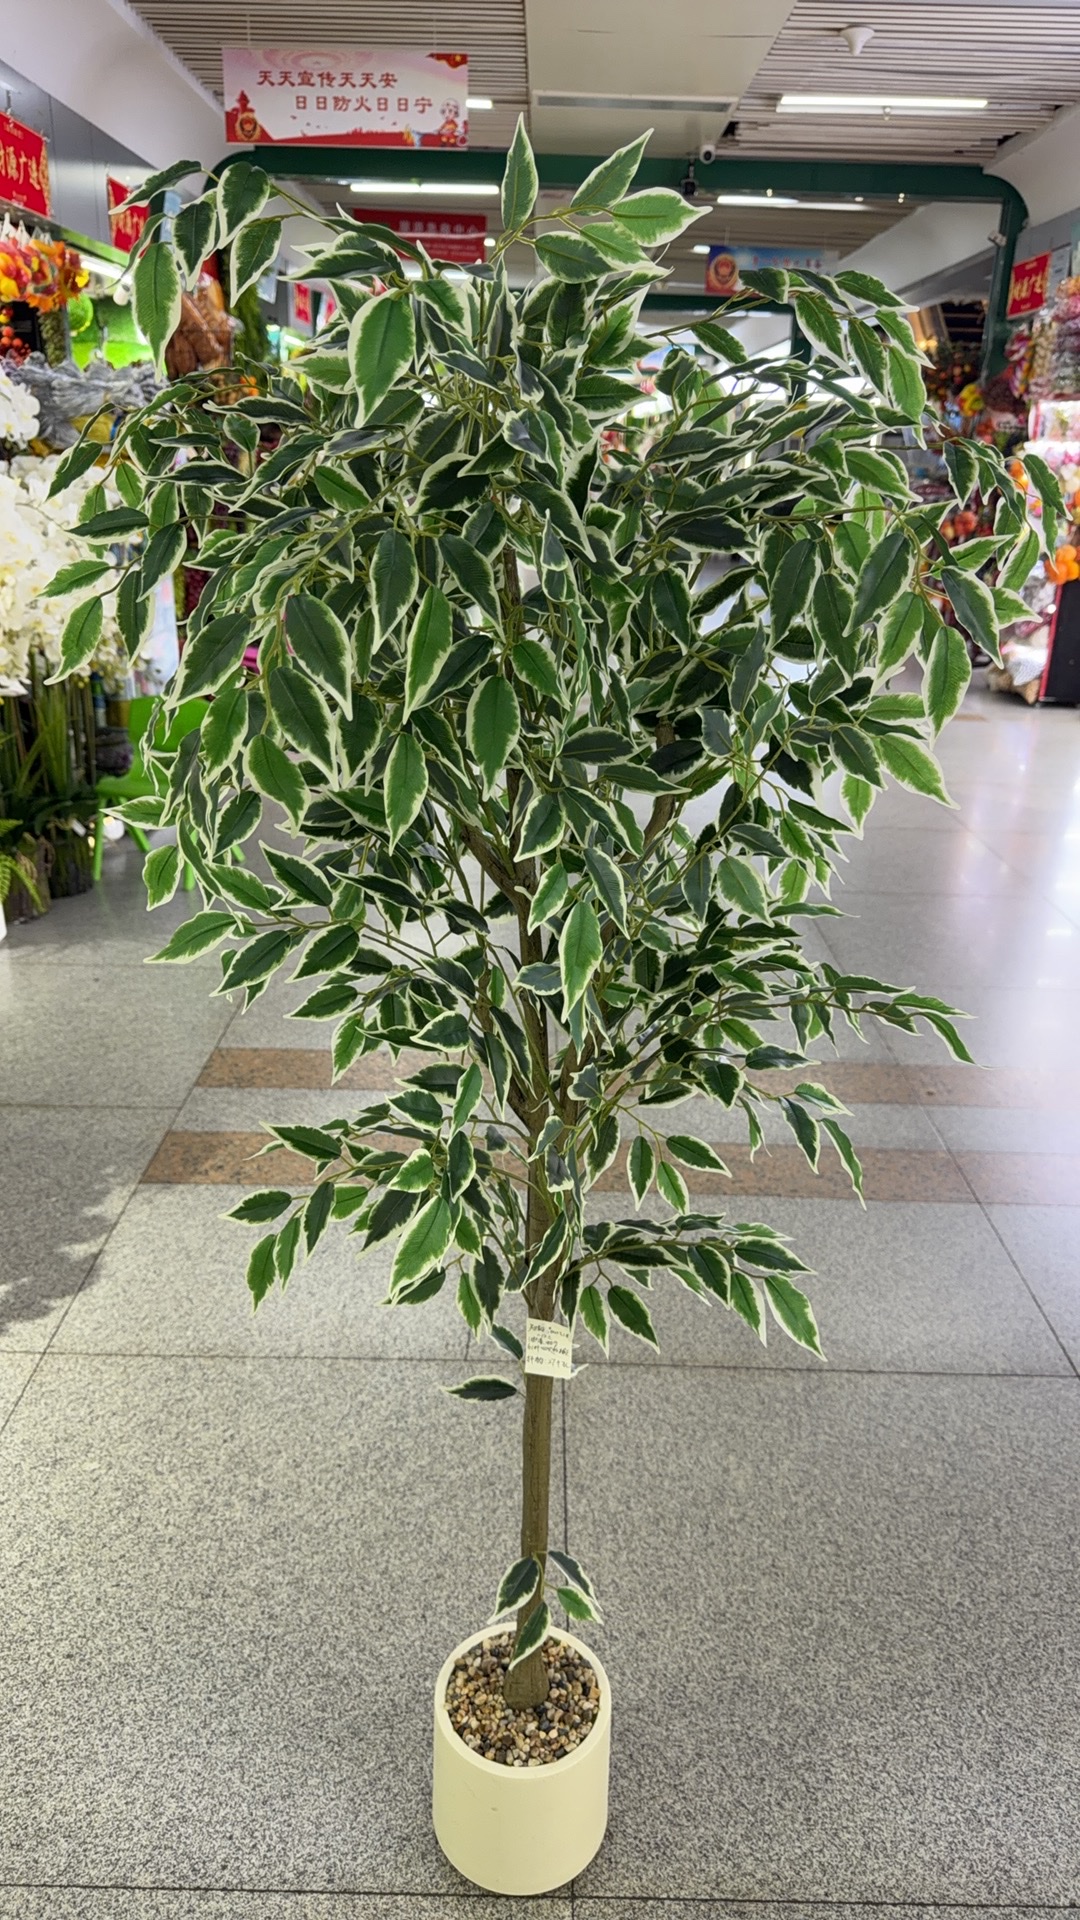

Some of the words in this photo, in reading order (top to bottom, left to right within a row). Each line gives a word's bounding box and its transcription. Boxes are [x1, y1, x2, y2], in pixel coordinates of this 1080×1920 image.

[256, 70, 399, 89] 天天宣传天天安
[295, 94, 433, 114] 日日防火日日宁
